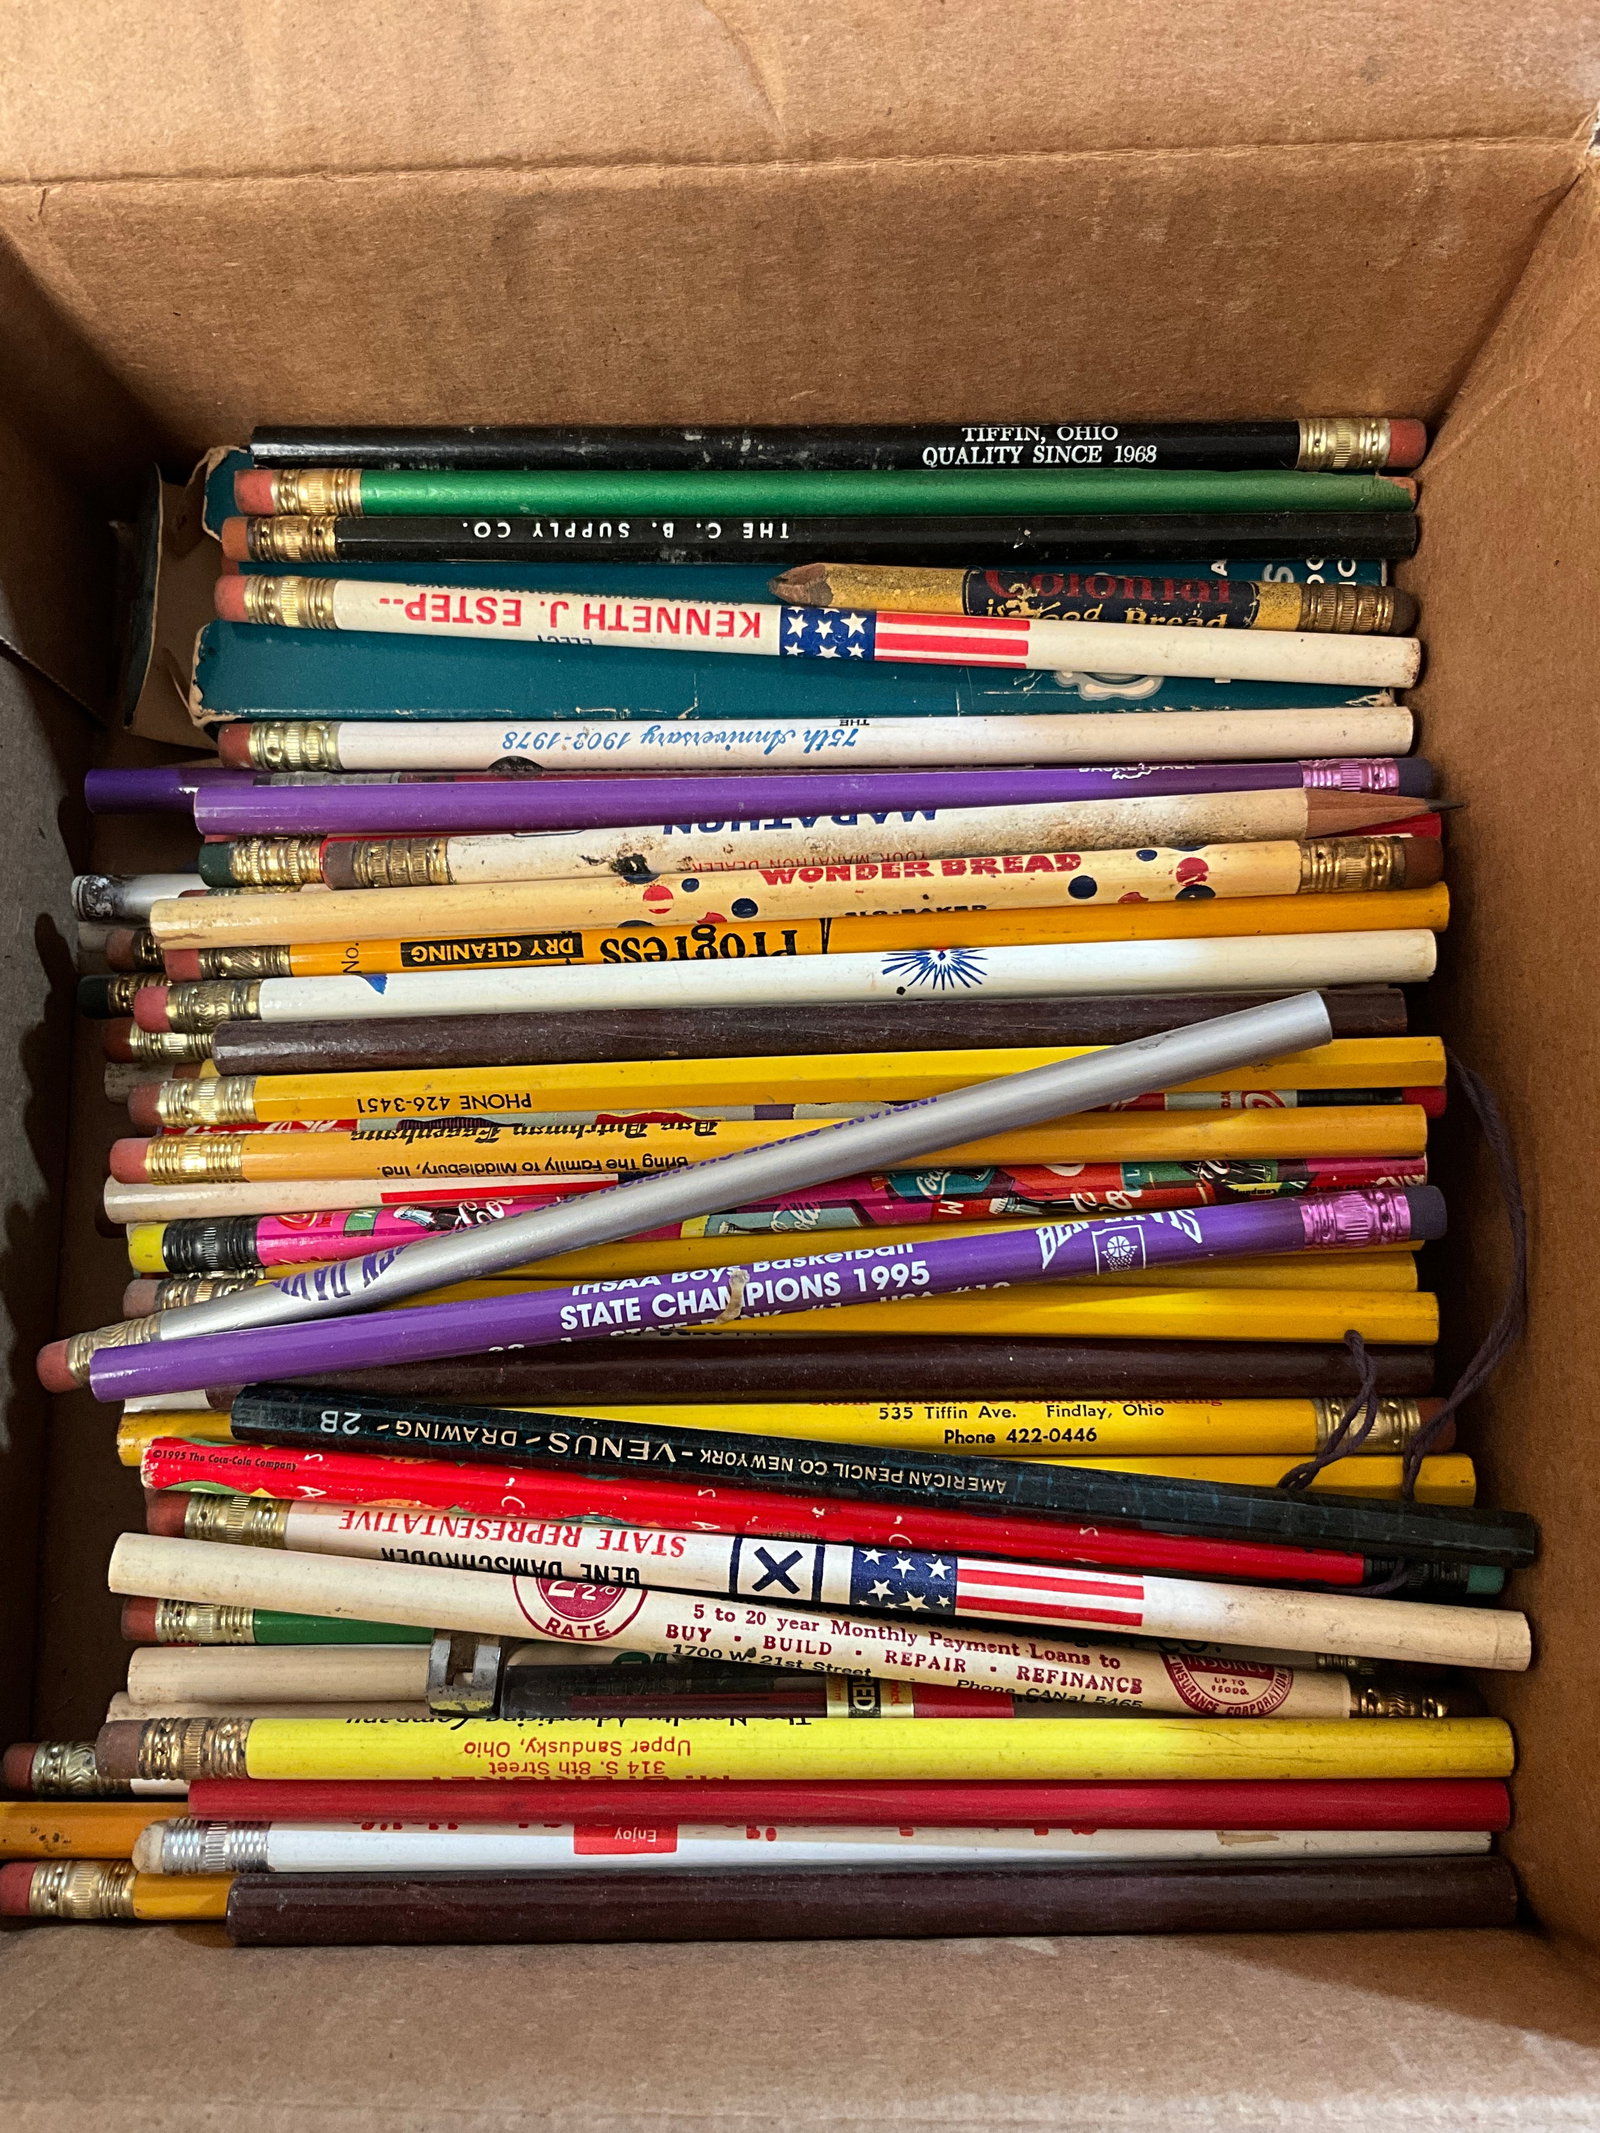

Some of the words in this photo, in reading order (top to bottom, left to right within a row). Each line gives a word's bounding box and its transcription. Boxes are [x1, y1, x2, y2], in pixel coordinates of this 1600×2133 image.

[961, 426, 1047, 445] TIFFIN,
[1056, 426, 1119, 442] OHIO
[922, 446, 1024, 468] QUALITY
[1032, 445, 1103, 464] SINCE
[1113, 445, 1158, 464] 1968
[462, 522, 512, 539] CO.
[532, 522, 631, 539] SUPPLY
[651, 522, 676, 539] B.
[695, 522, 723, 540] C.
[743, 522, 790, 540] THE
[539, 600, 569, 629] J.
[582, 603, 762, 639] KENNETH
[501, 730, 632, 751] 1903-1978
[640, 723, 797, 756] Anniversary
[802, 728, 858, 754] 75th
[757, 857, 935, 886] WONDER
[940, 852, 1083, 877] BREAD
[410, 940, 523, 964] CLEANING
[527, 937, 575, 958] DRY
[356, 1095, 452, 1115] 426-3451
[459, 1092, 532, 1110] PHONE
[545, 1156, 601, 1174] Family
[608, 1156, 636, 1171] The
[560, 1299, 642, 1332] STATE
[853, 1259, 931, 1294] 1995
[319, 1409, 362, 1434] 2B
[878, 1405, 914, 1421] 535
[923, 1405, 968, 1420] Tiffin
[977, 1404, 1018, 1420] Ave.
[1045, 1403, 1114, 1420] Findlay,
[1122, 1402, 1166, 1418] Ohio
[395, 1419, 518, 1448] DRAWING
[943, 1429, 996, 1445] Phone
[1005, 1426, 1099, 1444] 422-0446
[546, 1432, 677, 1464] VENUS
[188, 1452, 206, 1463] The
[207, 1454, 252, 1467] Coca-Cola
[254, 1457, 298, 1472] Company
[832, 1462, 904, 1483] PENCIL
[908, 1470, 1008, 1495] AMERICAN
[338, 1508, 583, 1548] REPRESENTATIVE
[596, 1528, 688, 1559] STATE
[579, 1562, 641, 1587] GENE
[544, 1616, 610, 1639] RATE
[693, 1603, 705, 1620] 5
[714, 1606, 736, 1624] to
[745, 1609, 767, 1627] 20
[775, 1615, 821, 1633] year
[830, 1619, 918, 1647] Monthly
[928, 1630, 1021, 1658] Payment
[1030, 1642, 1091, 1667] Loans
[1098, 1652, 1121, 1670] to
[665, 1623, 712, 1644] BUY
[762, 1634, 833, 1657] BUILD
[884, 1649, 967, 1674] REPAIR
[1015, 1664, 1144, 1696] REFINANCE
[671, 1643, 723, 1660] 1700
[758, 1654, 804, 1669] 21st
[1170, 1661, 1221, 1712] INSURANCE
[1225, 1671, 1290, 1717] CORPORATION
[1214, 1676, 1228, 1685] UP
[1231, 1678, 1246, 1687] TO
[463, 1741, 512, 1758] Ohio
[520, 1739, 623, 1758] Sandusky,
[630, 1740, 692, 1757] Upper
[488, 1761, 549, 1776] Street
[558, 1761, 591, 1776] 8th
[599, 1761, 619, 1776] S.
[625, 1761, 667, 1776] 314
[613, 1828, 657, 1843] Enjoy
